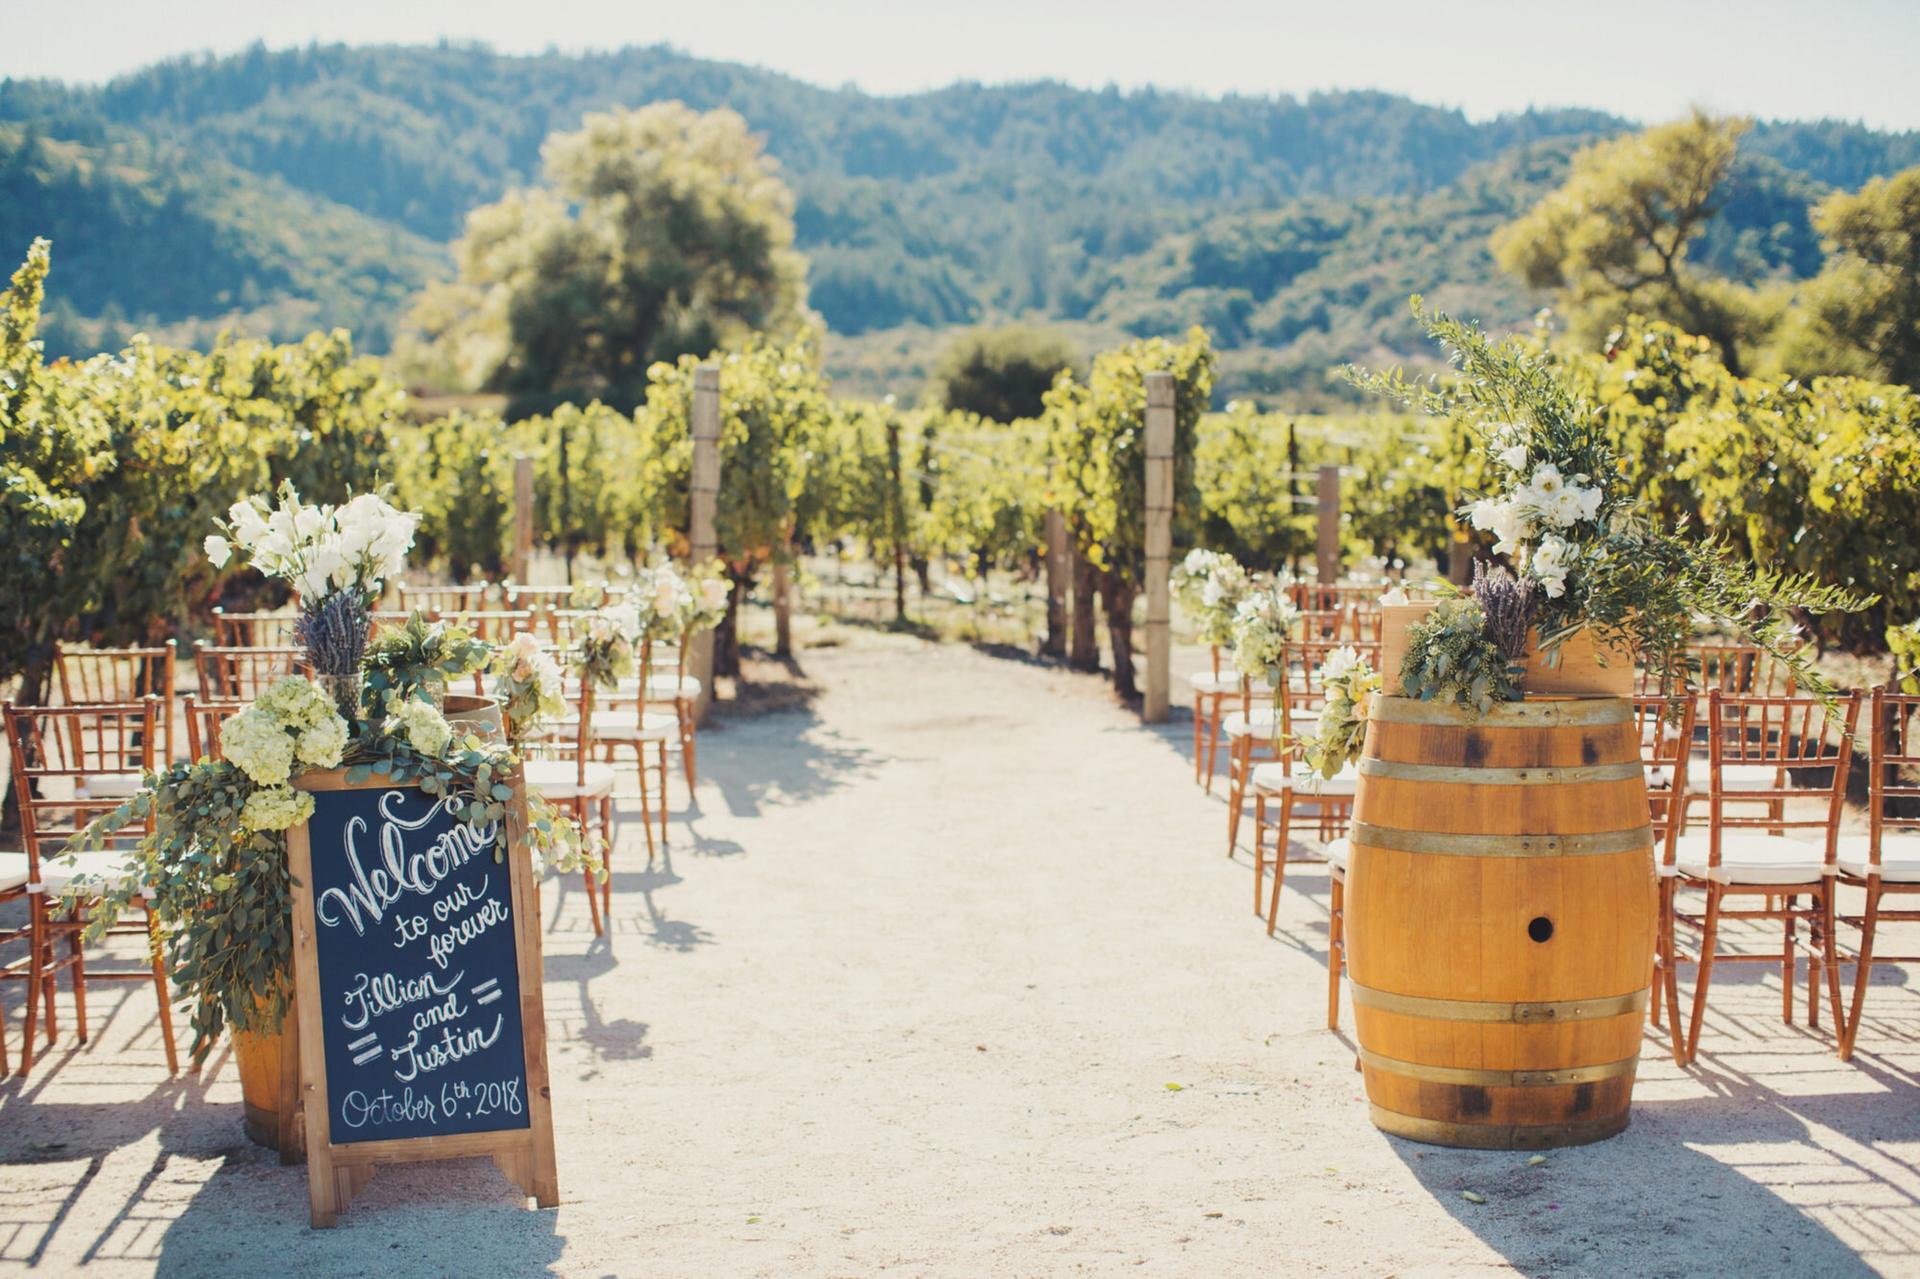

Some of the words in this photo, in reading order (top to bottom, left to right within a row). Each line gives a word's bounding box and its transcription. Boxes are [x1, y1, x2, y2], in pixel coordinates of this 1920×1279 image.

[317, 791, 498, 937] Welcome
[393, 914, 429, 948] to
[433, 874, 488, 922] our
[426, 898, 509, 969] forever
[341, 970, 464, 1031] Jillian
[413, 993, 468, 1031] and
[391, 1013, 504, 1083] Justin
[342, 1087, 437, 1128] October
[474, 1076, 522, 1115] 2018
